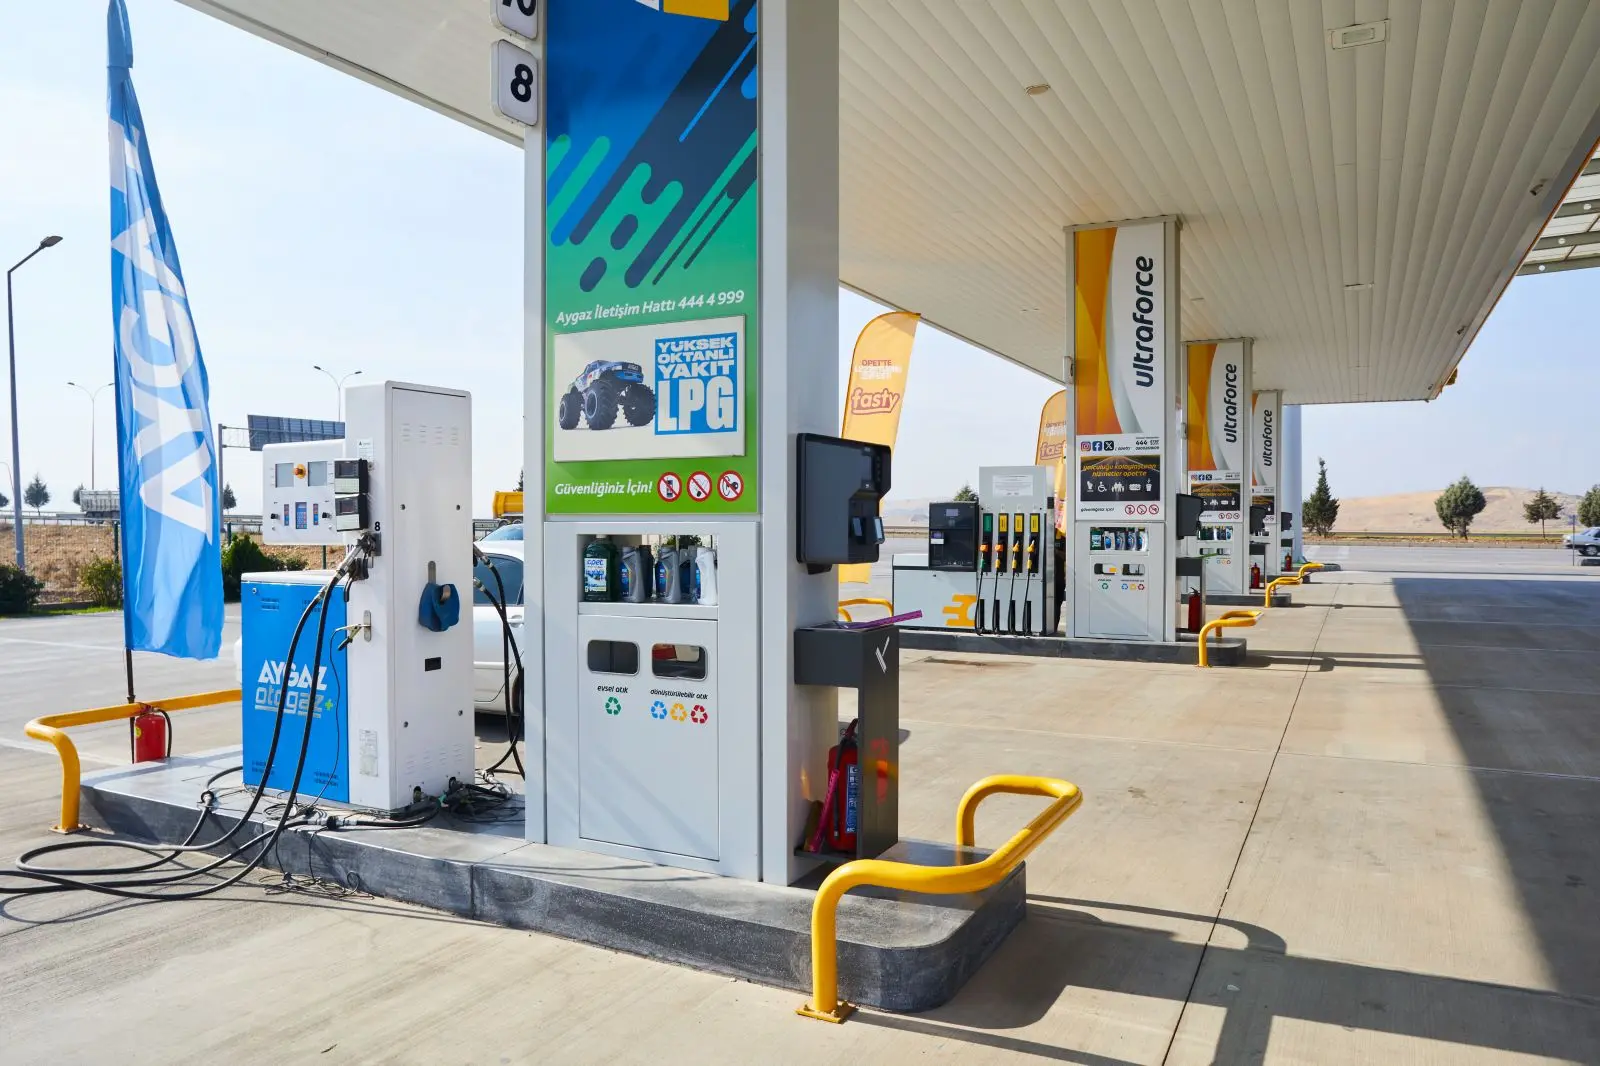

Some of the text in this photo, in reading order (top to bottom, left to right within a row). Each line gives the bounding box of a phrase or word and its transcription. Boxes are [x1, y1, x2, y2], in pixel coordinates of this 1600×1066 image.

[511, 64, 534, 103] 8
[556, 290, 745, 326] Aygaz İletişim Hattı 444 4 999
[1132, 255, 1154, 388] ultraforce
[658, 348, 734, 364] OKTANLI
[658, 360, 734, 379] YAKIT
[658, 376, 734, 431] LPG
[850, 387, 901, 415] fasty
[1223, 363, 1237, 443] ultraforce
[1262, 409, 1273, 467] ultraforce
[554, 478, 653, 498] Güvenliğiniz İçin!
[374, 521, 381, 532] 8
[257, 659, 328, 691] AYGAZ
[597, 685, 615, 693] evsel
